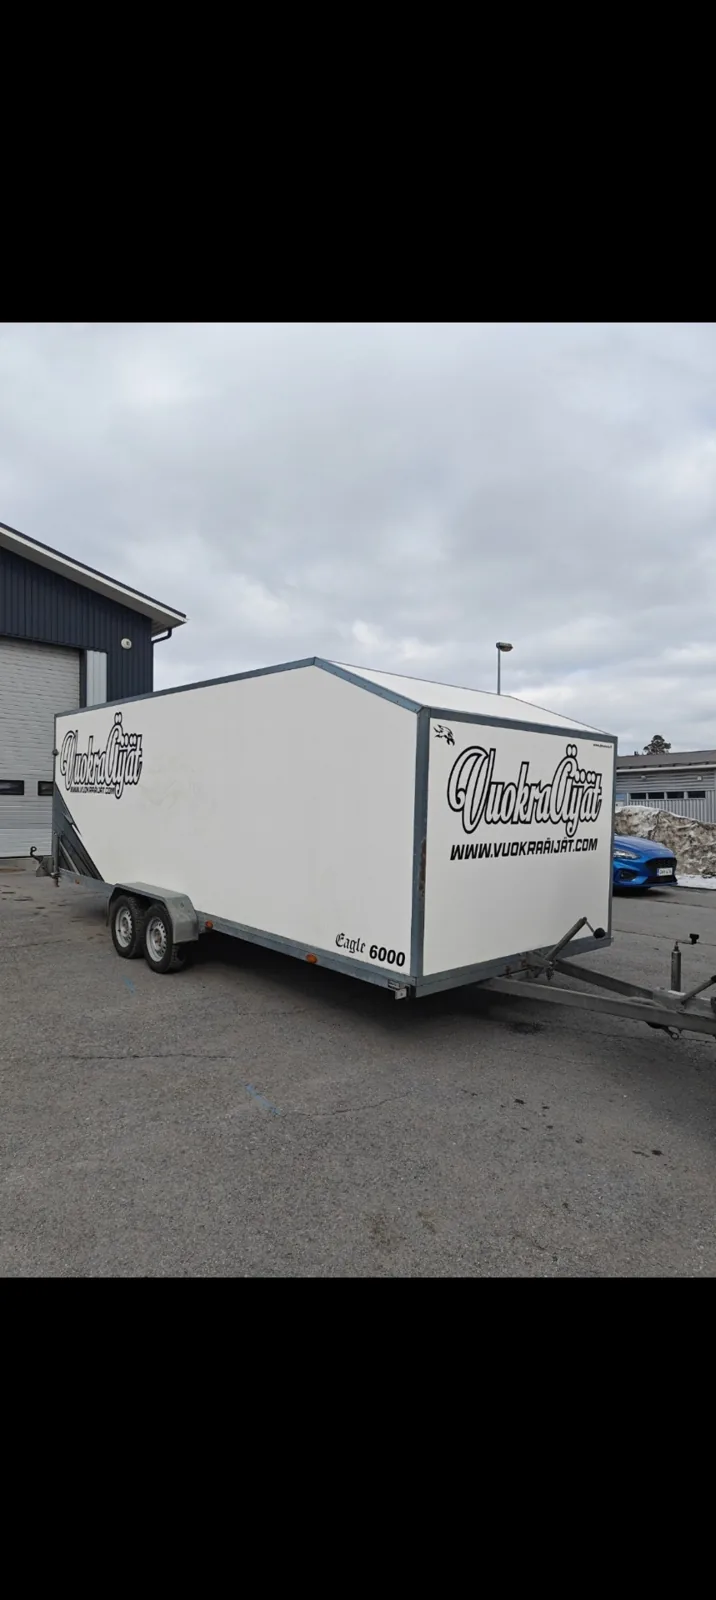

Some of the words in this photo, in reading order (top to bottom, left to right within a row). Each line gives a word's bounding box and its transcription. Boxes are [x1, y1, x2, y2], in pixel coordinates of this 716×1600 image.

[447, 743, 602, 837] VuokraÄijät
[450, 837, 598, 860] WWW.VUOKRAÄIJÄT.COM
[335, 933, 366, 953] Eagle
[369, 944, 405, 966] 6000
